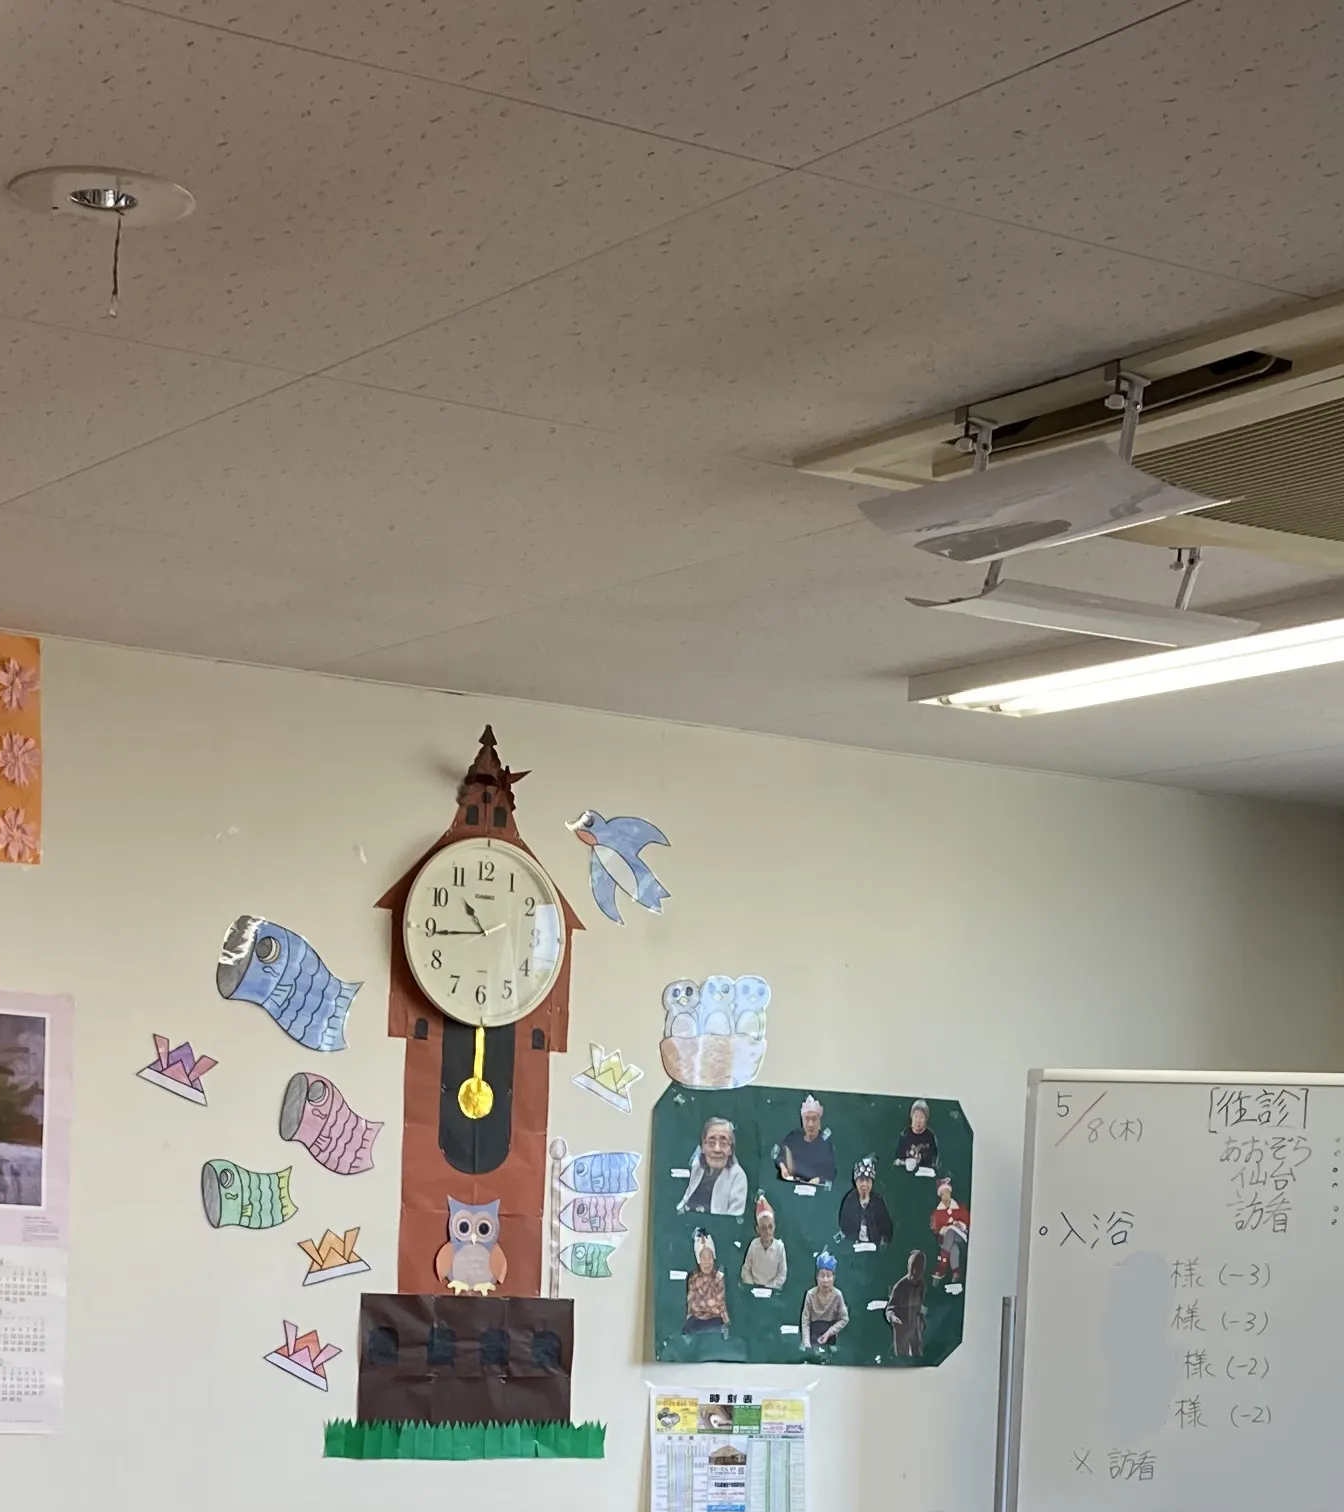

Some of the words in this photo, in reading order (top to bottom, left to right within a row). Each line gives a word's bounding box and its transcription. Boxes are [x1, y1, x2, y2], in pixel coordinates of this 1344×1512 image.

[452, 866, 465, 887] 11
[478, 861, 495, 882] 12
[508, 873, 515, 893] 1
[432, 887, 448, 907] 10
[524, 897, 535, 917] 2
[425, 917, 437, 938] 9
[529, 929, 541, 949] 3
[430, 949, 442, 970] 8
[519, 958, 531, 977] 4
[449, 974, 460, 994] 7
[501, 980, 513, 1000] 5
[475, 985, 487, 1005] 6
[1219, 1136, 1312, 1167] あおぞら
